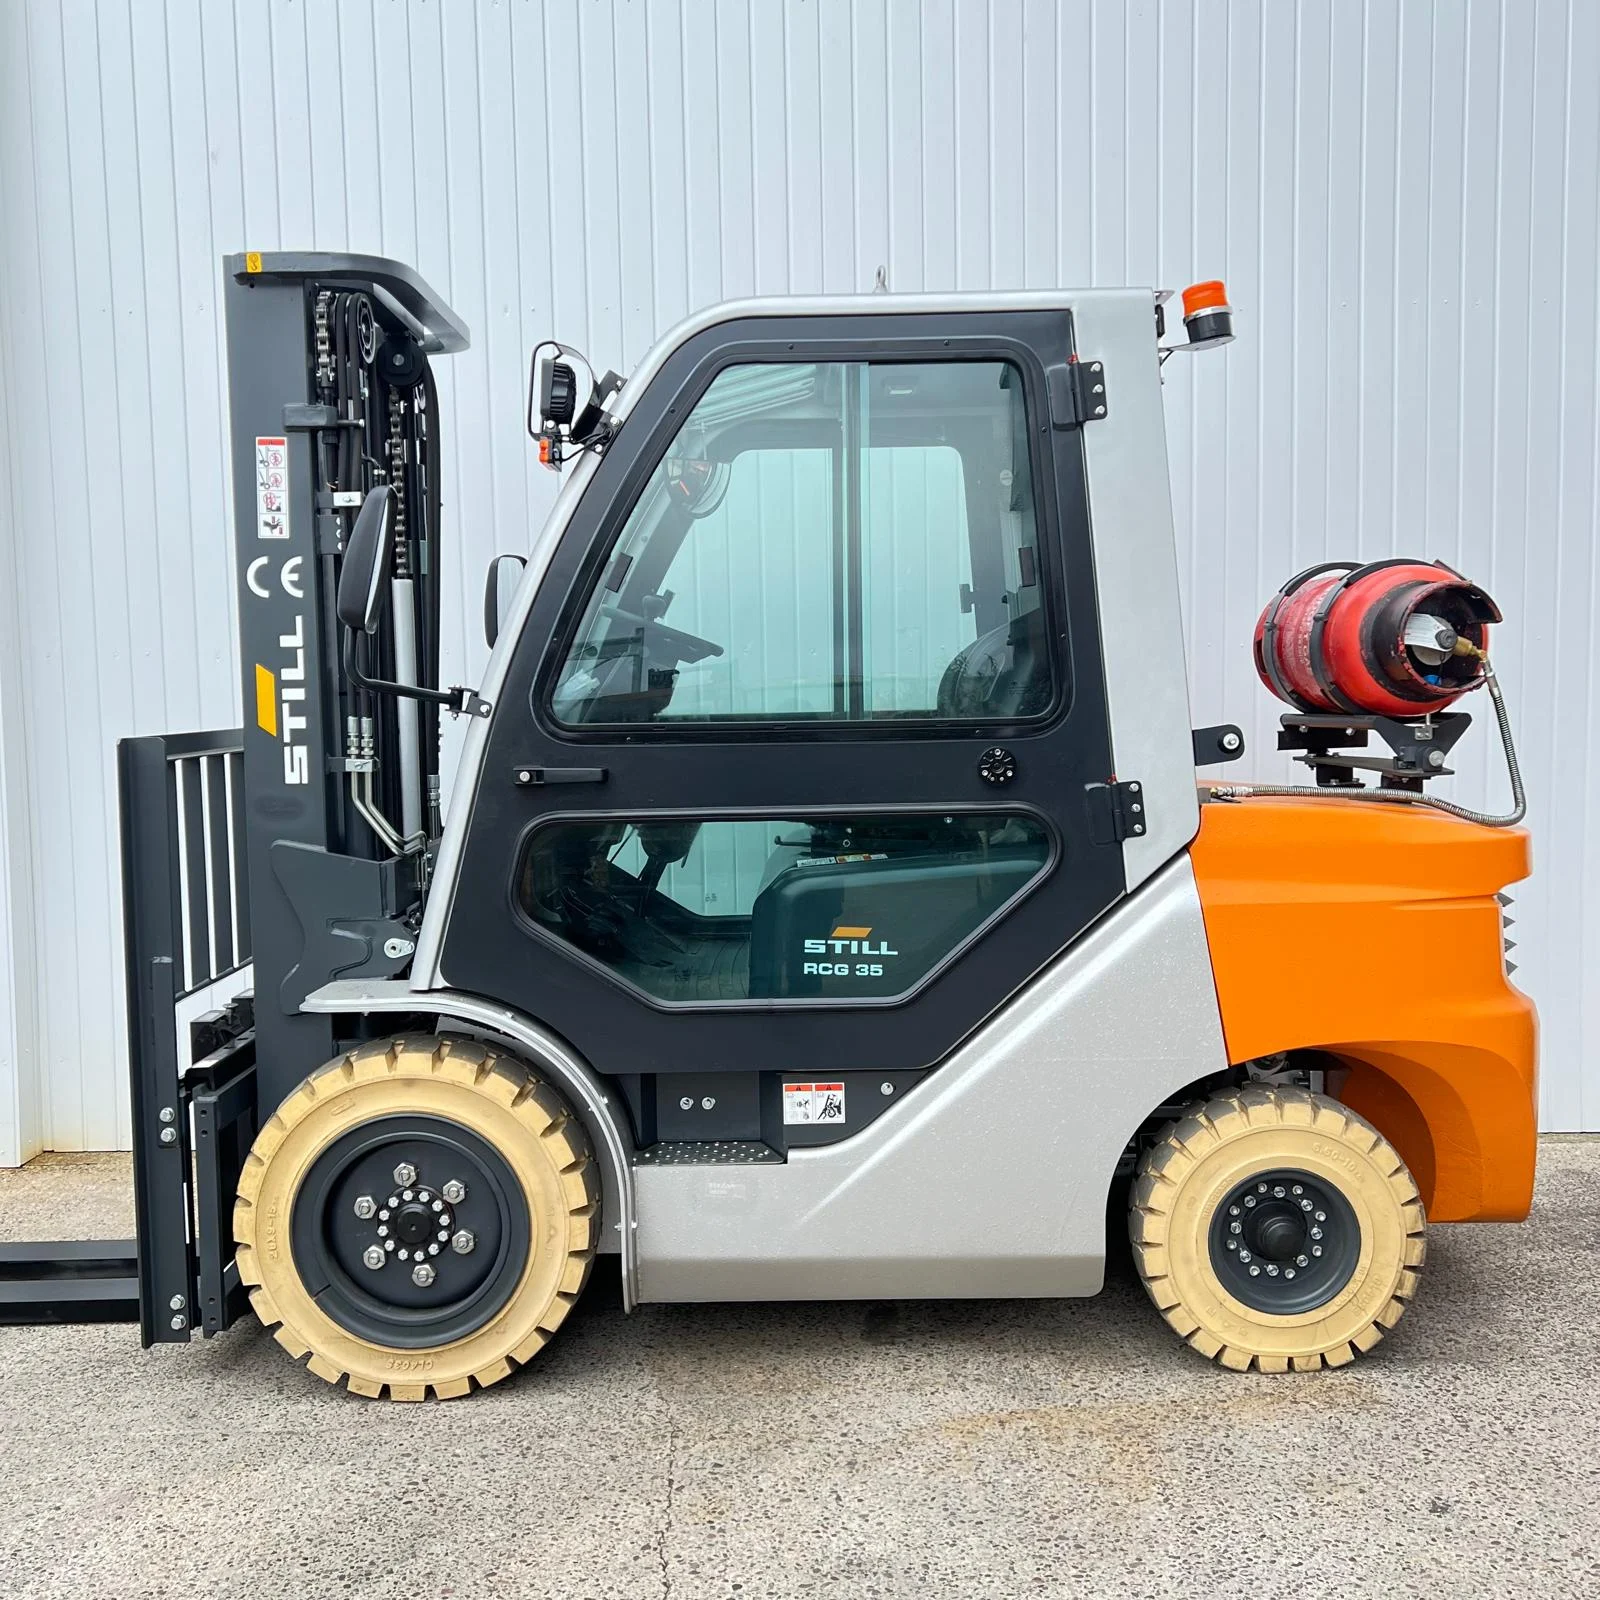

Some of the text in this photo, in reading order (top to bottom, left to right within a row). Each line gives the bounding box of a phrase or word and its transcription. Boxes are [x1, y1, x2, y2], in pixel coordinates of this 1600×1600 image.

[246, 556, 304, 598] CE
[279, 615, 308, 785] STILL
[804, 939, 899, 956] STILL
[803, 962, 883, 977] RCG 35
